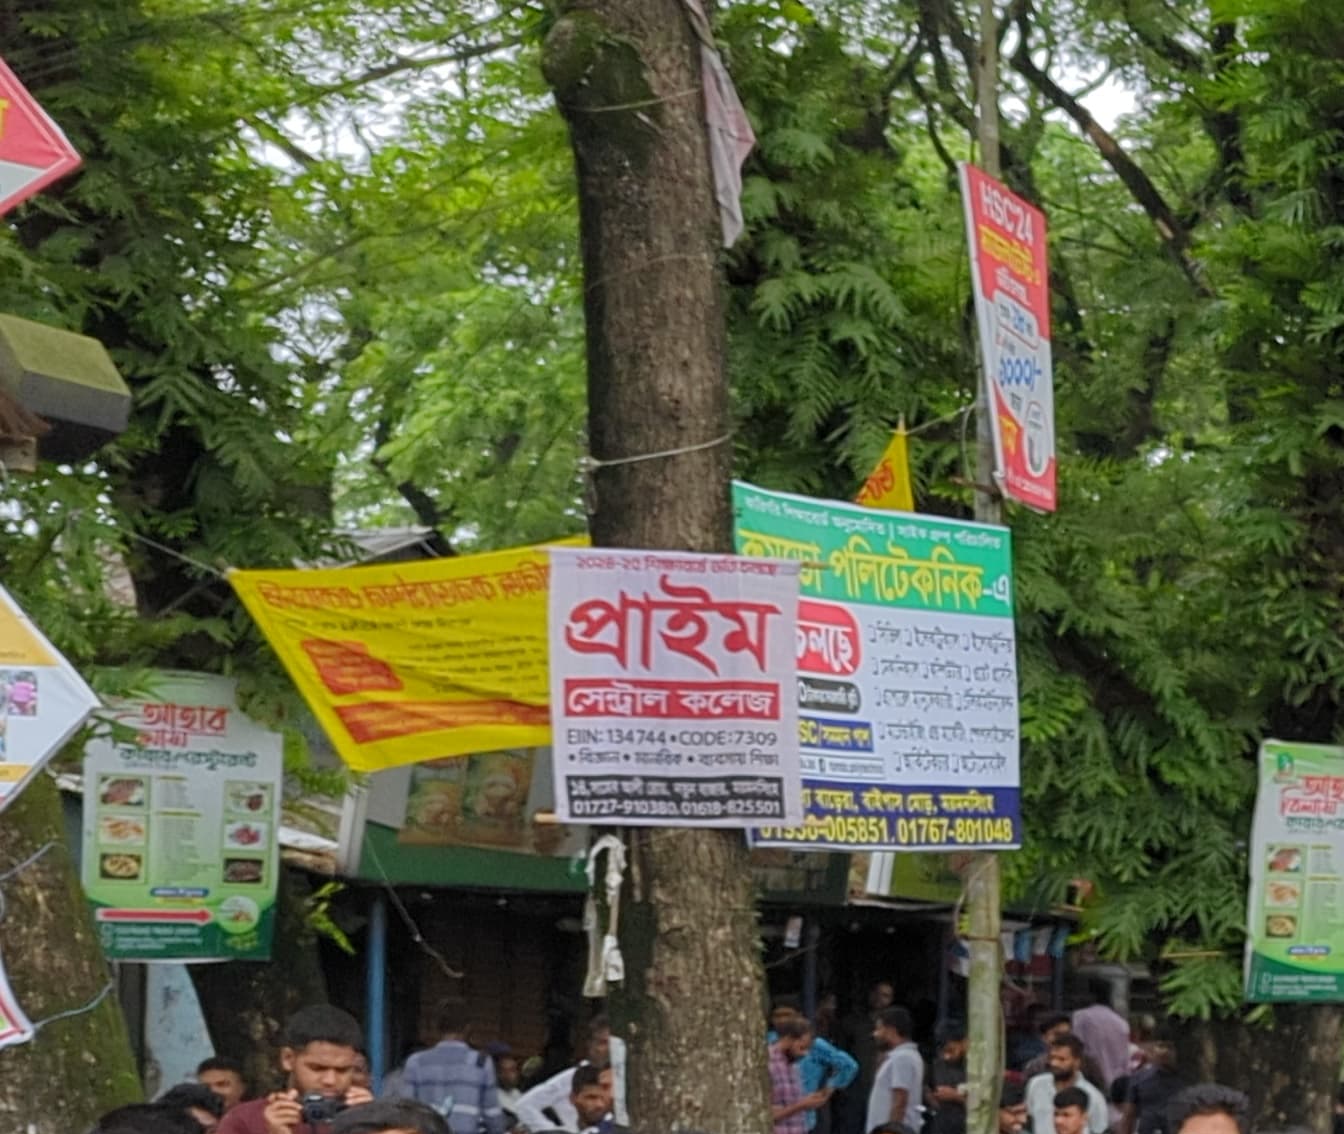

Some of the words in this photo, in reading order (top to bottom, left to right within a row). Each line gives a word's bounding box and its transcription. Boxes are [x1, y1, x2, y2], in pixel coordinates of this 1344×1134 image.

[565, 574, 782, 677] প্রাইম
[568, 682, 670, 716] সেন্ট্রাল
[676, 688, 775, 716] কলেজ
[142, 703, 230, 732] আহার
[607, 728, 667, 745] 134744
